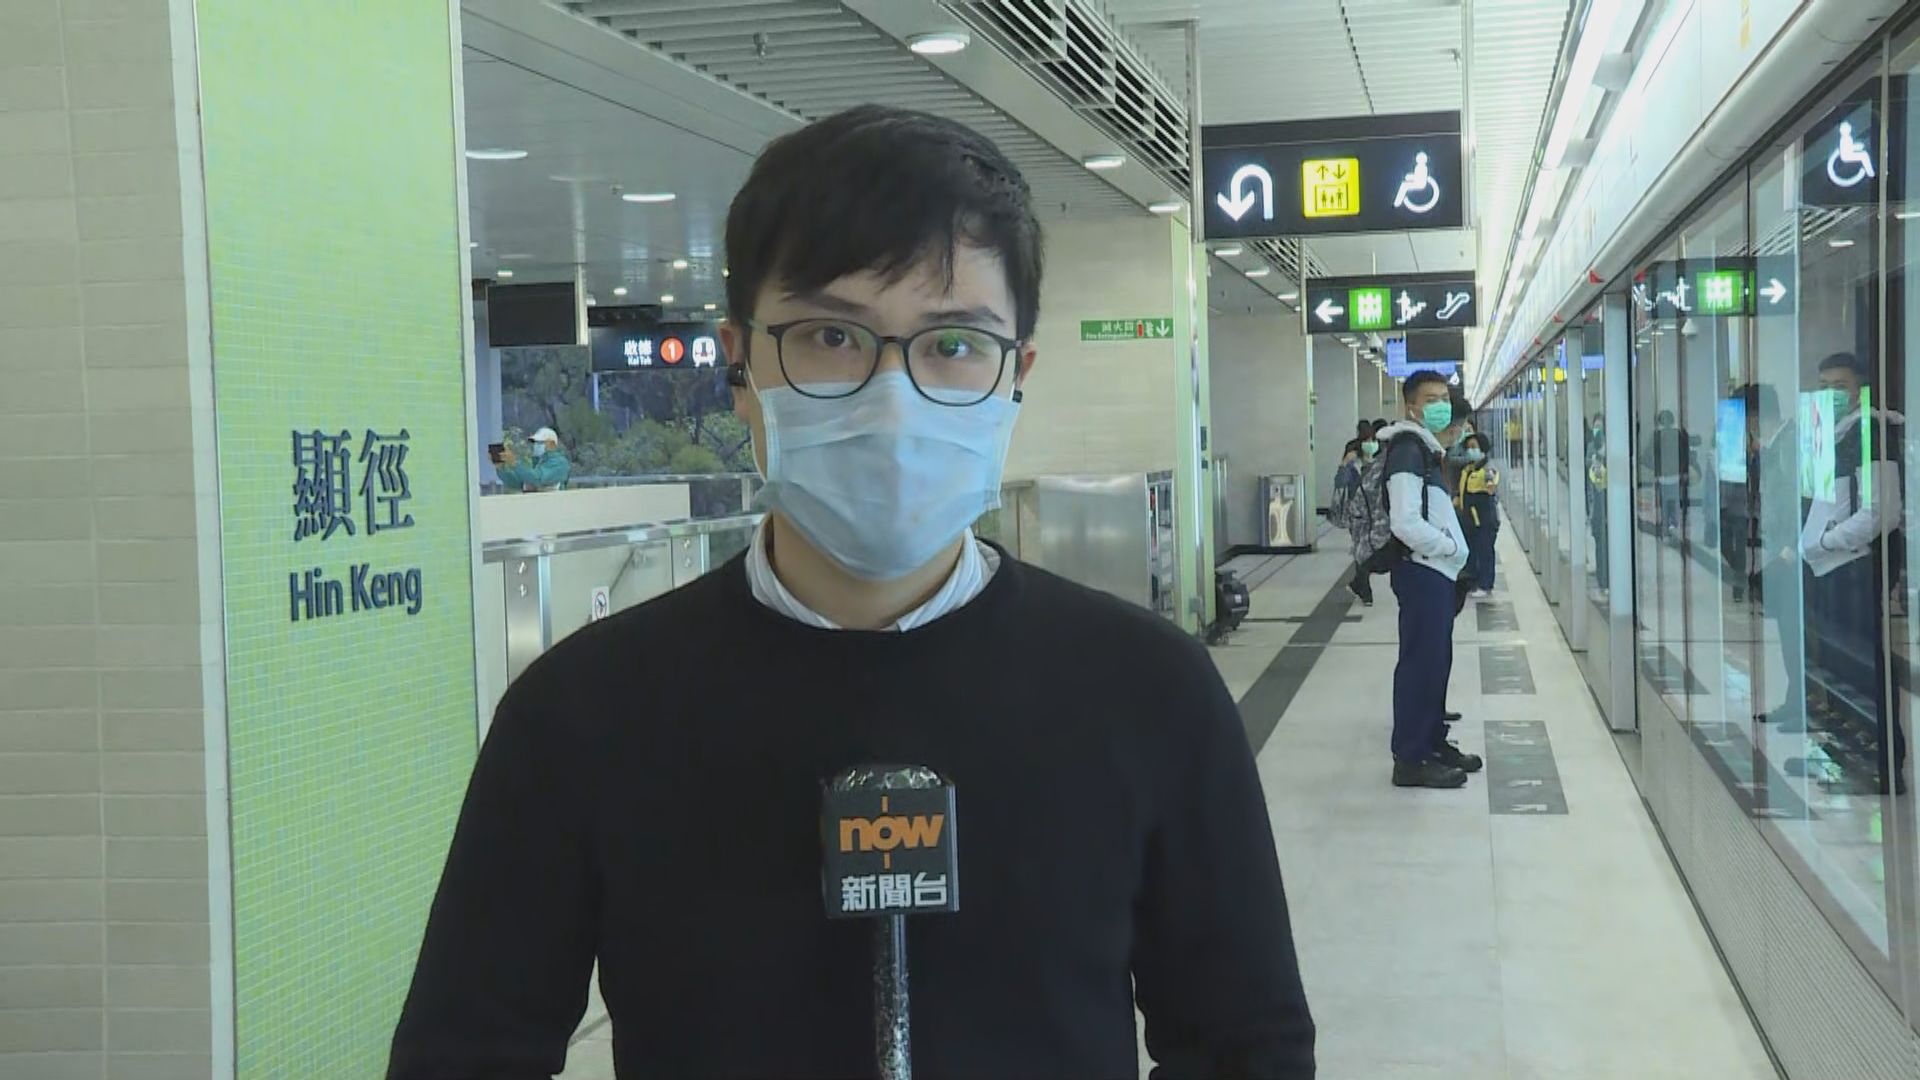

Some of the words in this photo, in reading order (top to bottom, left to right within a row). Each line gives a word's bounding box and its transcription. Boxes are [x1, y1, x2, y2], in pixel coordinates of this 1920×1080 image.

[668, 342, 676, 360] 1
[292, 428, 415, 541] 顯徑
[290, 567, 343, 621] Hin
[350, 562, 423, 615] Keng
[840, 815, 944, 852] now
[842, 872, 947, 912] 新聞台
